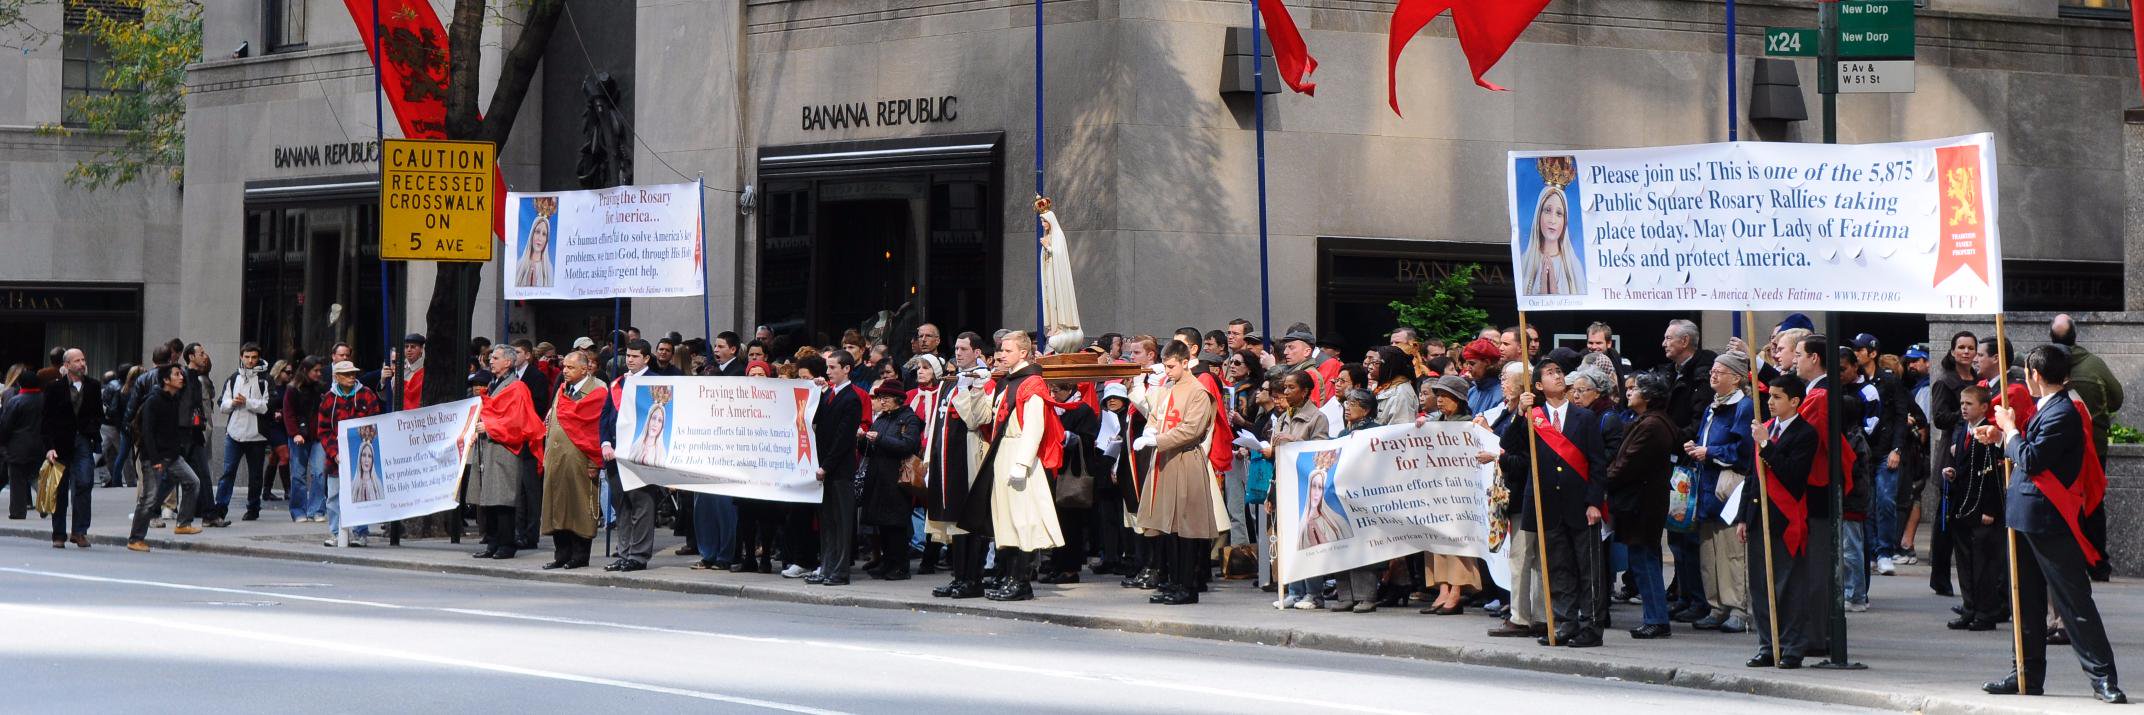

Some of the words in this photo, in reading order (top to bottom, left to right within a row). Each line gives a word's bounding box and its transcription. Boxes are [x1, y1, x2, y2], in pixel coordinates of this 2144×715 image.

[1842, 5, 1862, 14] New
[1866, 4, 1888, 15] Dorp
[1842, 32, 1862, 42] New
[1866, 32, 1889, 43] Dorp
[1842, 64, 1848, 72] 5
[1852, 64, 1864, 72] Av
[1867, 64, 1874, 72] &
[1843, 75, 1851, 84] W
[1855, 75, 1866, 84] 51
[1870, 75, 1880, 84] St
[802, 102, 870, 130] BANANA
[876, 96, 957, 126] REPUBLIC
[274, 146, 320, 168] BANANA
[325, 141, 379, 164] REPUBLIC
[393, 149, 484, 169] CAUTION
[1590, 165, 1639, 184] Please
[1643, 164, 1674, 187] join
[1679, 164, 1701, 181] us!
[1706, 161, 1747, 180] This
[1748, 160, 1760, 179] is
[1764, 166, 1797, 180] one
[1804, 162, 1828, 181] of
[1831, 163, 1863, 182] the
[1868, 160, 1913, 184] 5,875
[392, 175, 484, 192] RECESSED
[390, 194, 485, 211] CROSSWALK
[620, 191, 637, 203] the
[640, 189, 672, 206] Rosary
[1594, 192, 1642, 212] Public
[1647, 191, 1703, 215] Square
[1708, 190, 1764, 213] Rosary
[1769, 188, 1828, 209] Rallies
[1834, 191, 1899, 215] taking
[425, 214, 450, 228] ON
[567, 235, 576, 246] As
[577, 234, 598, 246] human
[620, 233, 629, 242] to
[631, 231, 651, 242] solve
[1596, 220, 1636, 245] place
[1641, 219, 1688, 243] today.
[1693, 218, 1727, 242] May
[1732, 217, 1766, 238] Our
[1771, 217, 1812, 242] Lady
[1818, 217, 1834, 238] of
[1839, 218, 1910, 239] Fatima
[410, 233, 422, 250] 5
[435, 239, 464, 252] AVE
[618, 247, 639, 261] God,
[642, 247, 670, 261] through
[1598, 249, 1636, 268] bless
[1641, 248, 1670, 267] and
[1676, 250, 1730, 271] protect
[1735, 247, 1811, 267] America.
[641, 265, 659, 279] help.
[1398, 257, 1505, 285] BANNA
[1601, 287, 1622, 300] The
[1624, 287, 1673, 300] American
[1676, 287, 1697, 300] TFP
[1710, 287, 1748, 300] America
[1752, 287, 1784, 301] Needs
[1787, 287, 1822, 301] Fatima
[1834, 290, 1901, 302] WWW.TFP.ORG
[1946, 294, 1978, 309] TFP
[699, 384, 734, 402] Praying
[735, 385, 750, 399] the
[751, 385, 777, 403] Rosary
[711, 404, 724, 418] for
[397, 417, 426, 432] Praying
[426, 414, 438, 427] the
[687, 426, 711, 436] human
[712, 426, 734, 436] efforts
[735, 426, 746, 436] fail
[746, 428, 753, 437] to
[409, 435, 420, 447] for
[725, 443, 734, 451] we
[751, 443, 758, 451] to
[1370, 433, 1434, 454] Praying
[1438, 430, 1459, 447] the
[758, 457, 768, 468] His
[1395, 457, 1420, 471] for
[1344, 487, 1359, 500] As
[1362, 482, 1403, 498] human
[1406, 478, 1442, 494] efforts
[1445, 476, 1462, 492] fail
[1464, 479, 1474, 489] to
[1350, 504, 1368, 515] key
[1372, 498, 1430, 518] problems,
[1432, 496, 1448, 505] we
[1450, 494, 1472, 505] turn
[1356, 516, 1376, 529] His
[1408, 512, 1453, 527] Mother,
